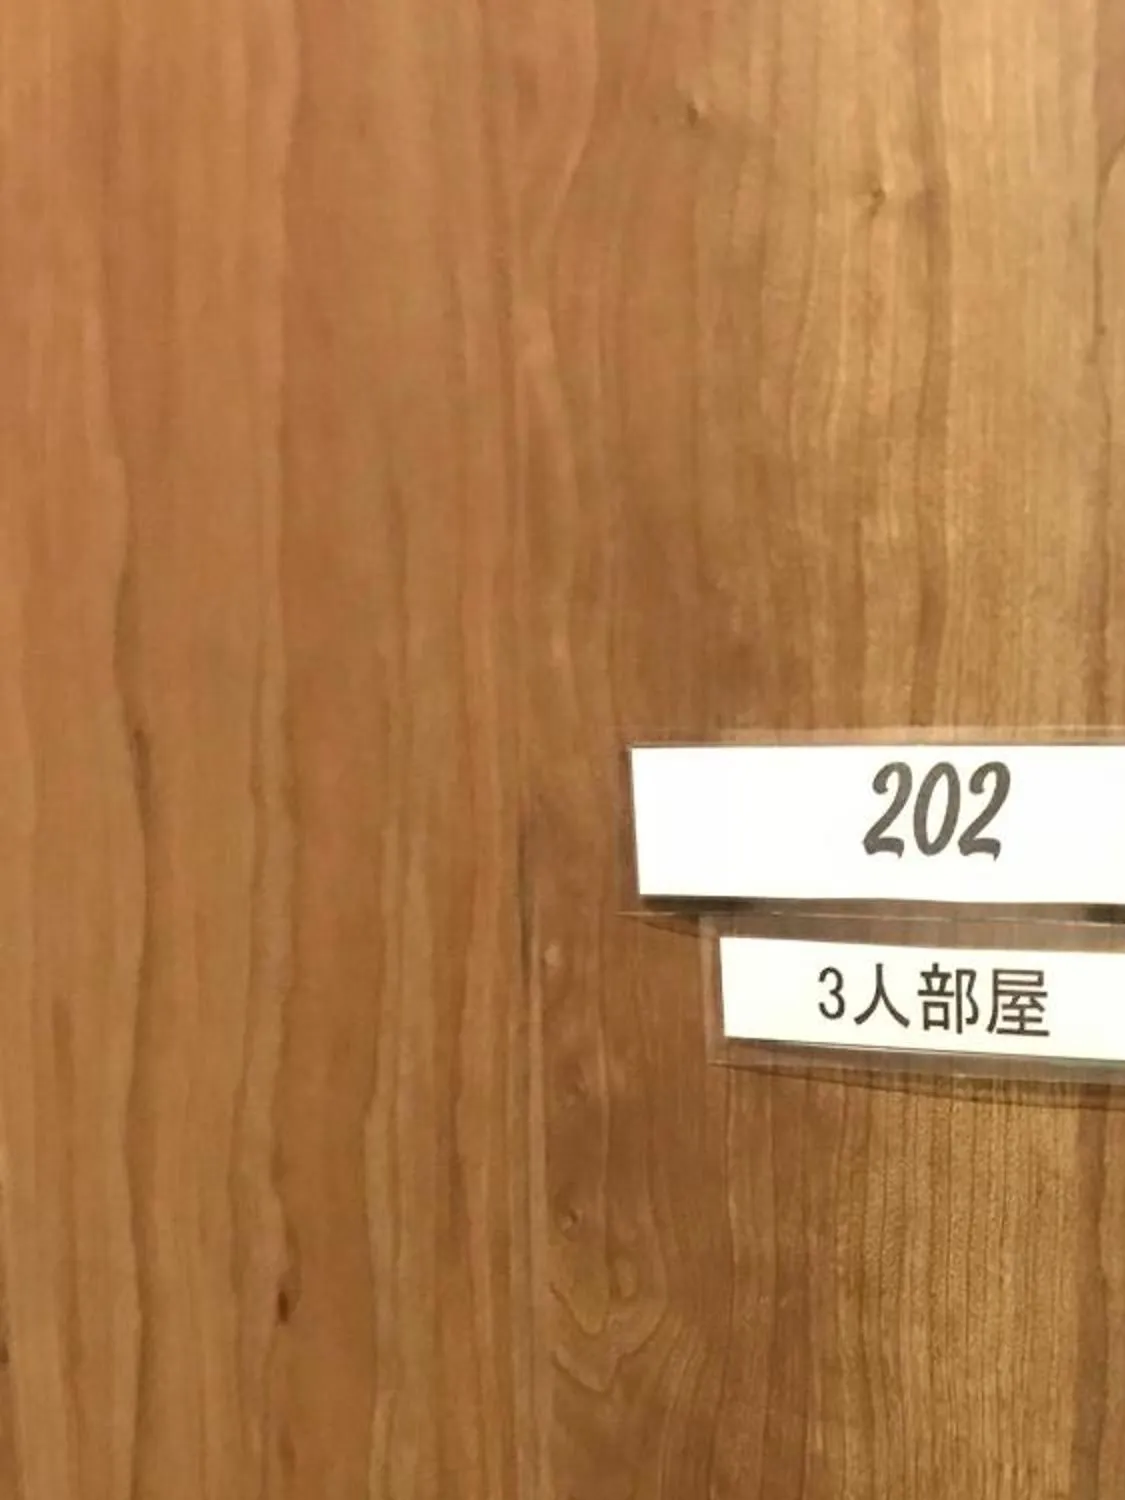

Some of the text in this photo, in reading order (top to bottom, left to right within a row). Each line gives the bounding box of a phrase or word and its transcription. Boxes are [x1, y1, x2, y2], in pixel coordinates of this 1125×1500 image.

[863, 761, 1011, 860] 202
[818, 962, 1051, 1038] 3人部屋
